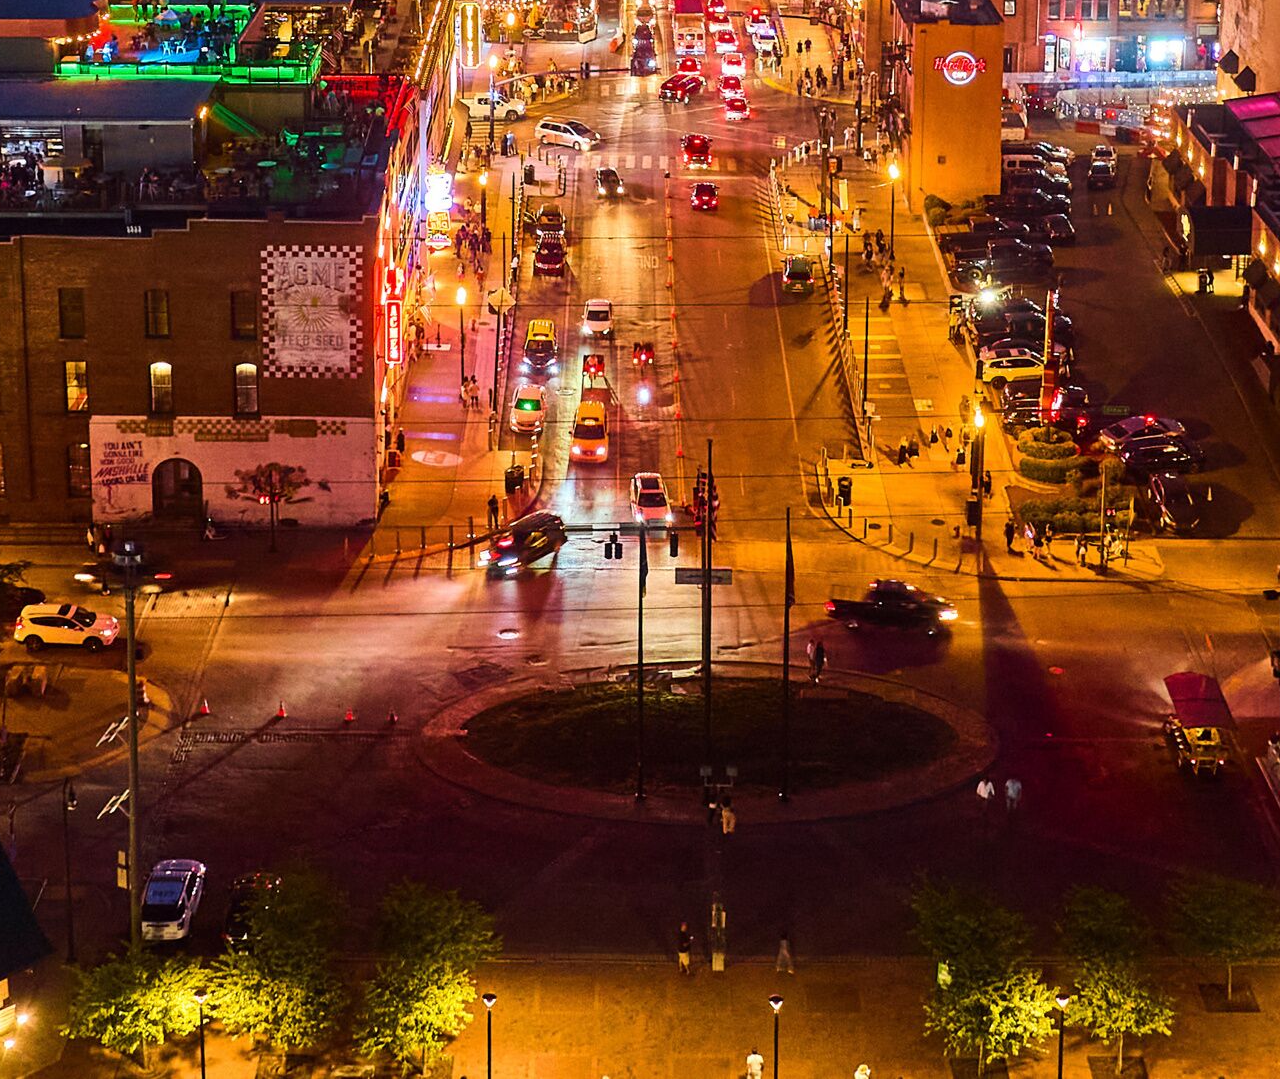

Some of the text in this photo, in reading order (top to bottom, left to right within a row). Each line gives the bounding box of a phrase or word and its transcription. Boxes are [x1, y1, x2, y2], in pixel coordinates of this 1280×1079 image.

[934, 57, 986, 73] Hard Rock
[273, 261, 346, 292] ACME
[281, 334, 344, 346] FEED SEED
[104, 440, 143, 450] YOU AIN'T
[94, 462, 150, 479] NASHVILLE
